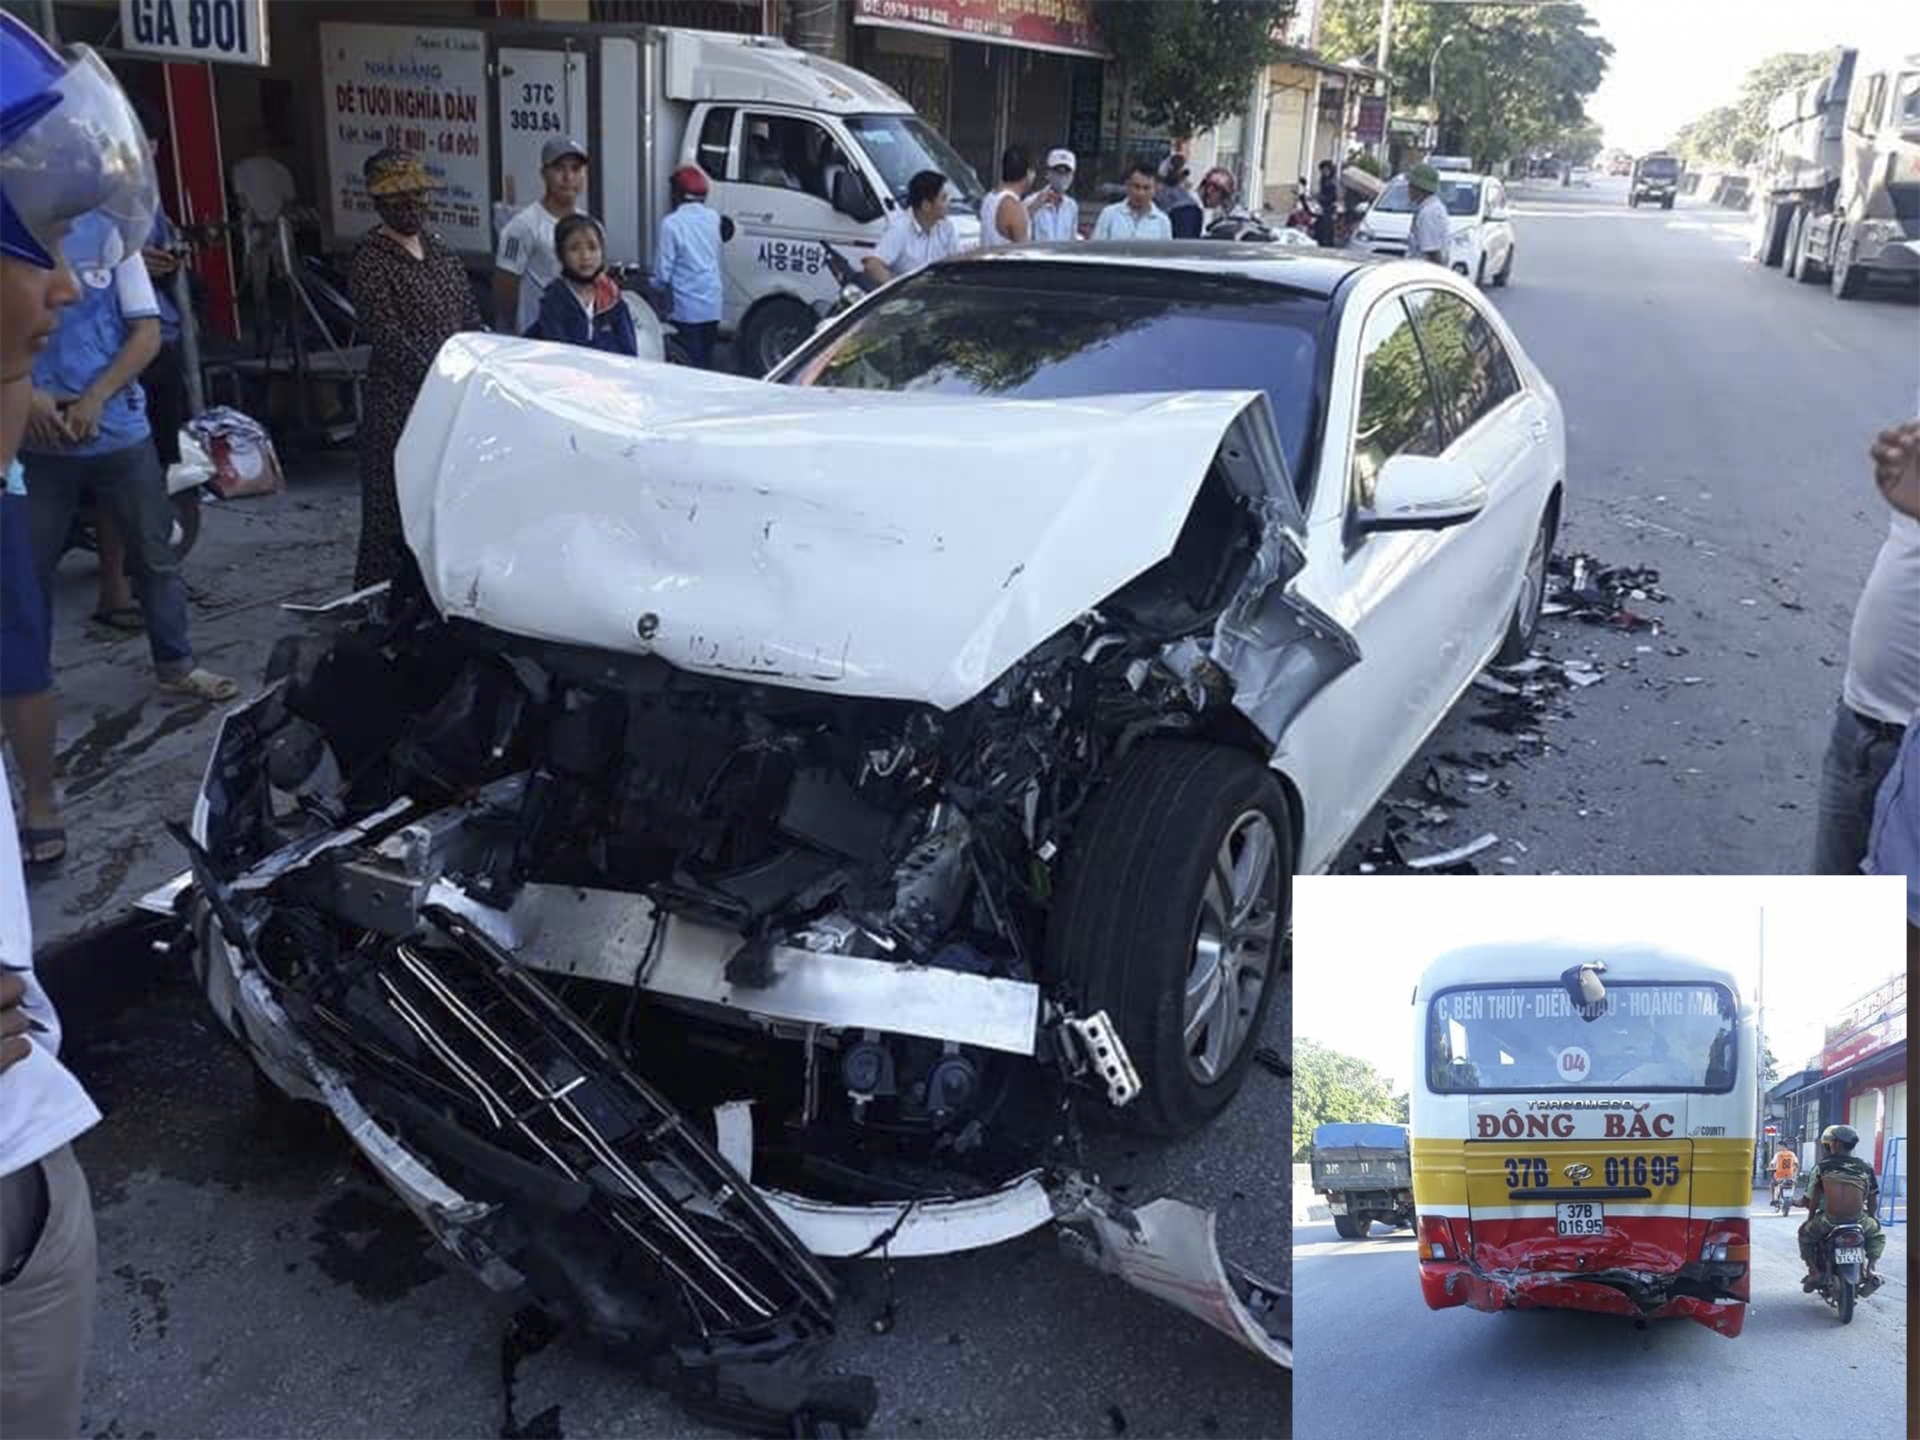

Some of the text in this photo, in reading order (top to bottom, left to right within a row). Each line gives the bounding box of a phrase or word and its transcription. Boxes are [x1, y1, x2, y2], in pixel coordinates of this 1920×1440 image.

[522, 83, 554, 105] 37C
[1454, 991, 1483, 1020] BẾN
[1629, 986, 1683, 1017] HOÀNG
[1563, 1054, 1586, 1072] 04
[1477, 1102, 1675, 1138] ĐÔNG BẮC
[1700, 1125, 1726, 1136] COUNTY
[1504, 1155, 1680, 1188] 37B 01695
[1567, 1204, 1593, 1218] 37B
[1559, 1219, 1603, 1234] 016.95
